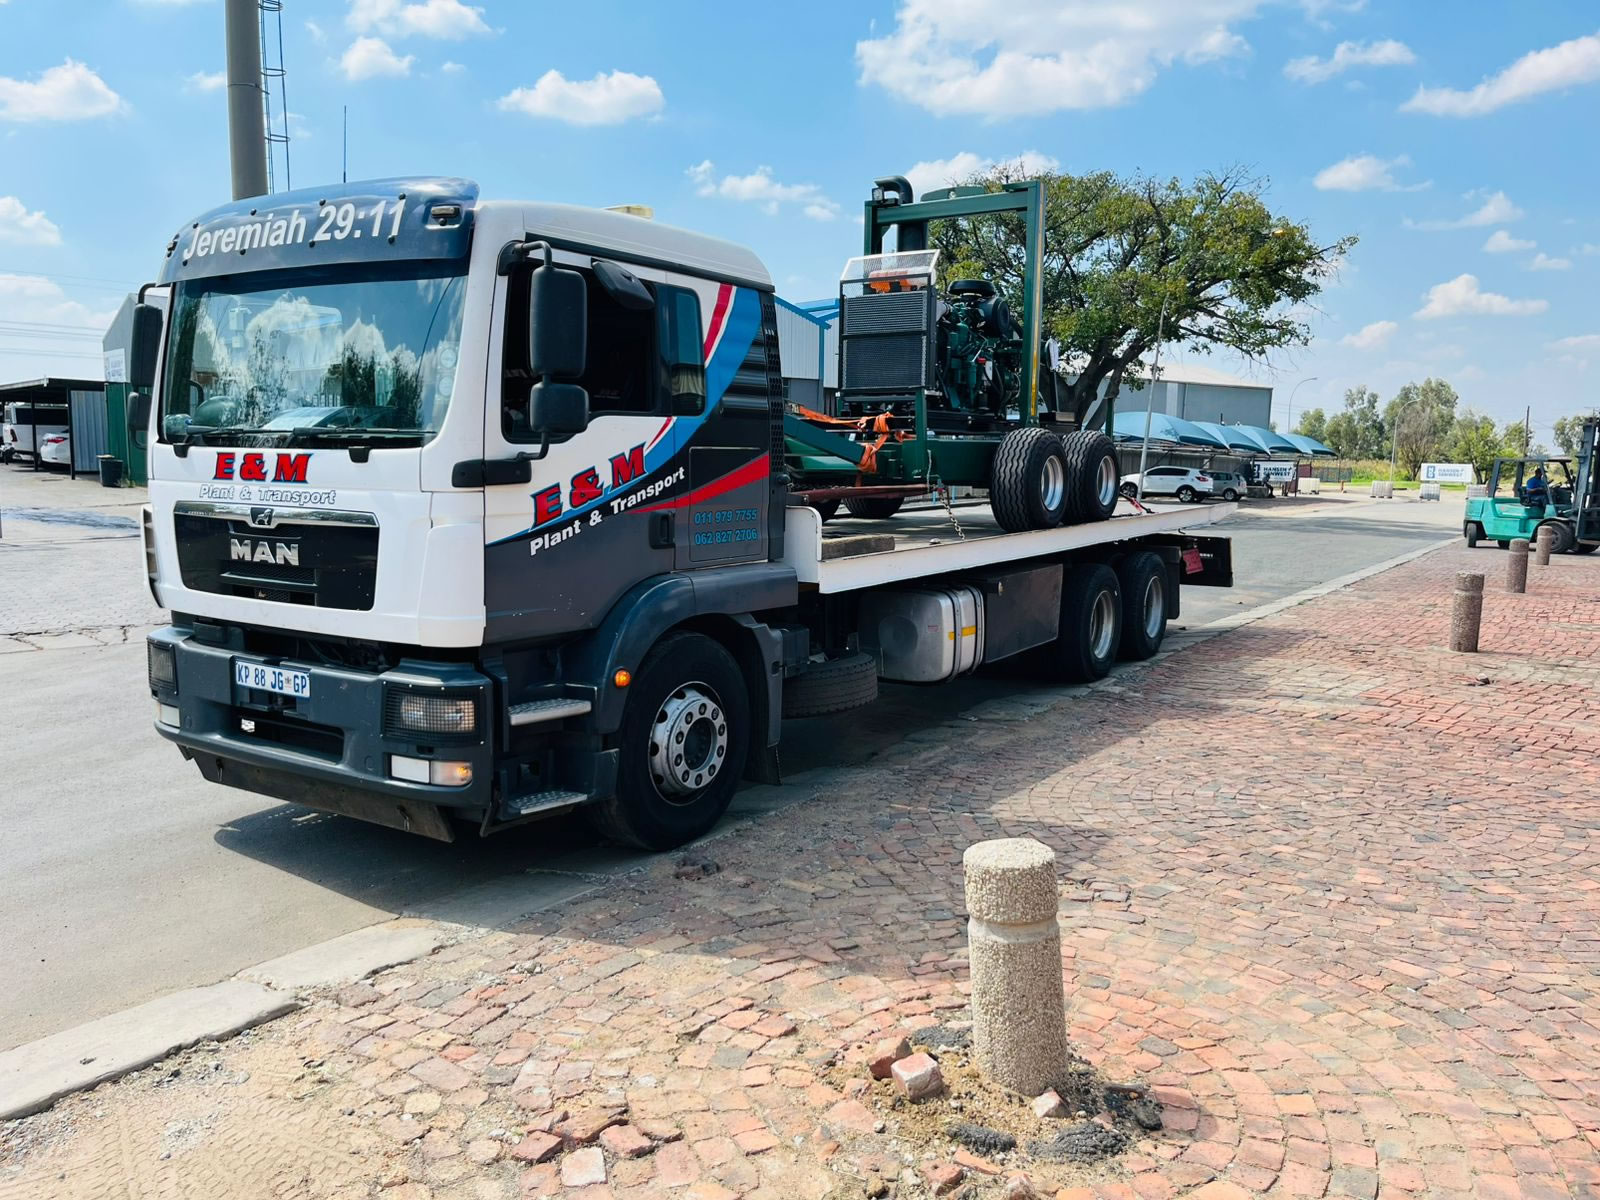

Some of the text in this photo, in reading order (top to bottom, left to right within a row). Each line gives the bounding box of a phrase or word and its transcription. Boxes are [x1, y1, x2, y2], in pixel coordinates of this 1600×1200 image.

[183, 198, 407, 260] Jeremiah 29:11
[199, 484, 337, 506] Plant & Transport
[530, 466, 686, 556] Plant & Transport
[694, 507, 758, 525] 011 979 7755
[694, 527, 758, 545] 062 827 2706
[230, 538, 299, 566] MAN
[238, 664, 307, 694] KP 88 JG GP
